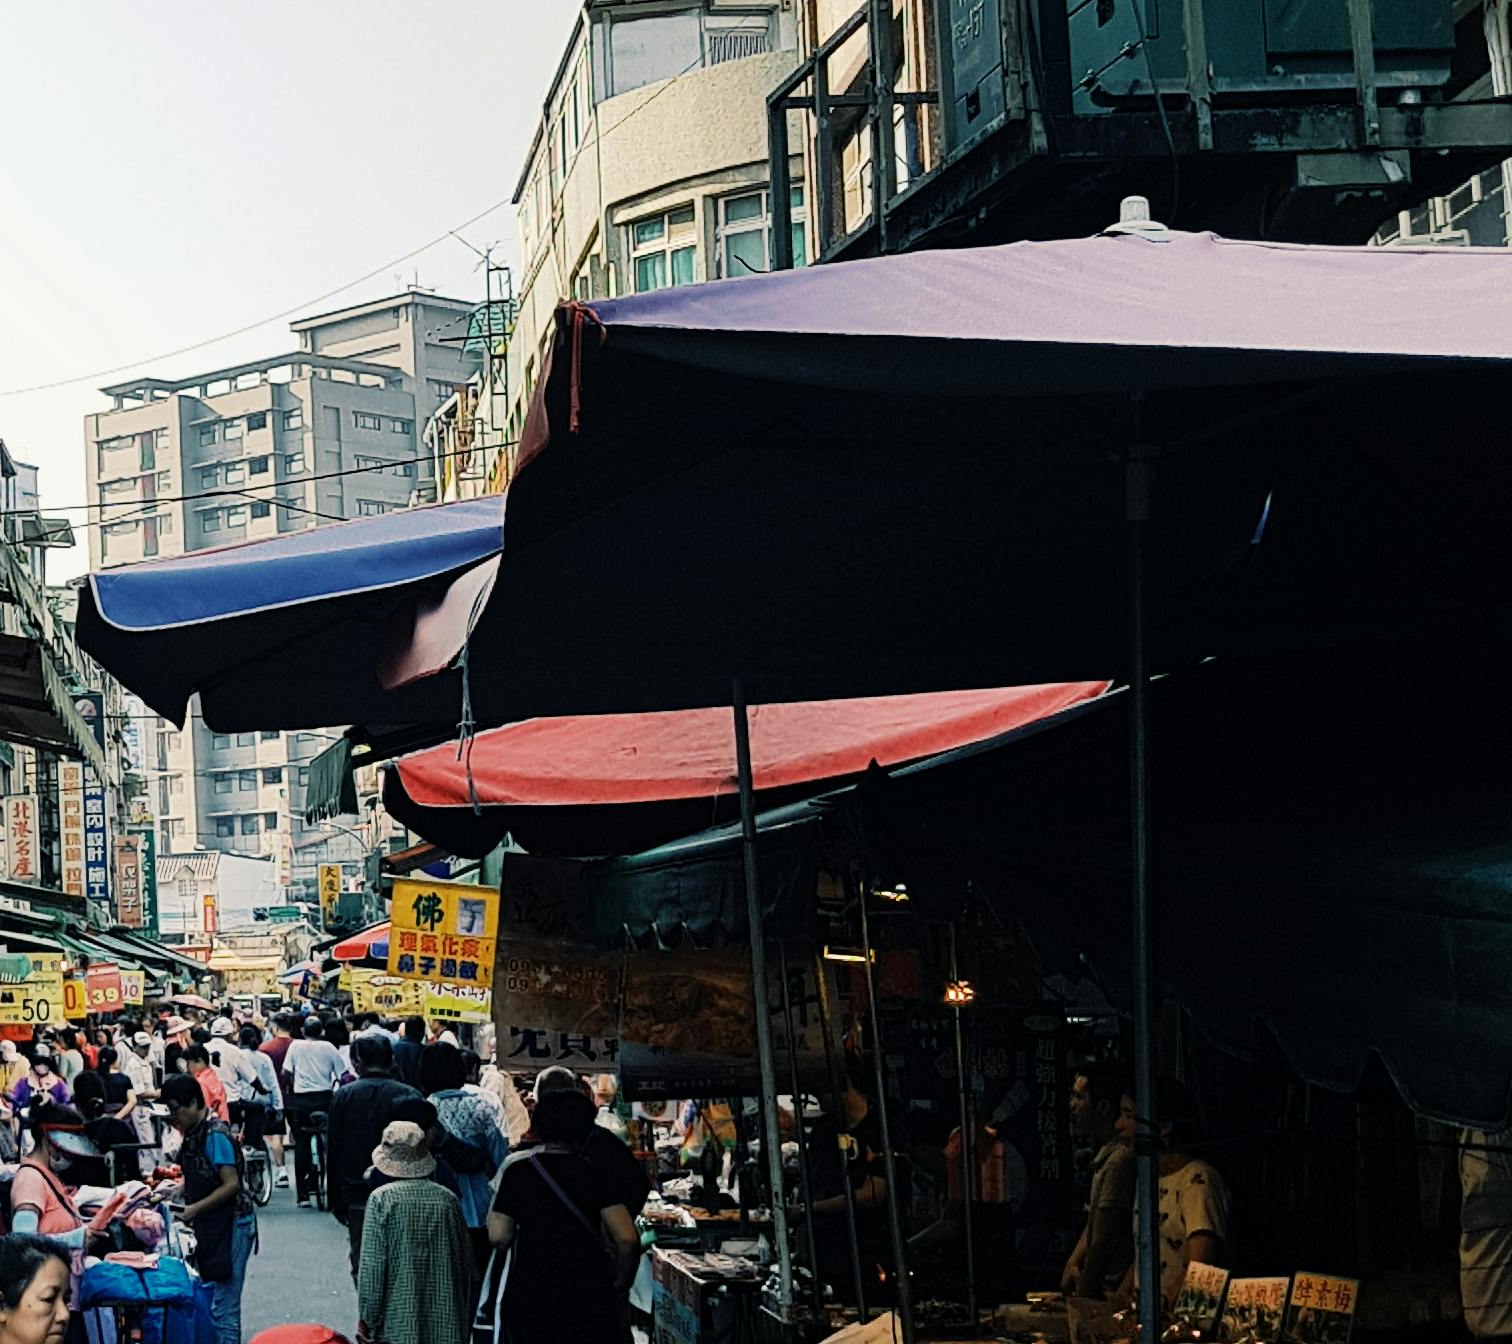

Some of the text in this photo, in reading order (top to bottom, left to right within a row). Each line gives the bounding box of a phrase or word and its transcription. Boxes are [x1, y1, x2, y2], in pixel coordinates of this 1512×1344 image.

[12, 800, 34, 876] 北港名產
[411, 891, 445, 931] 佛
[22, 998, 50, 1022] 50
